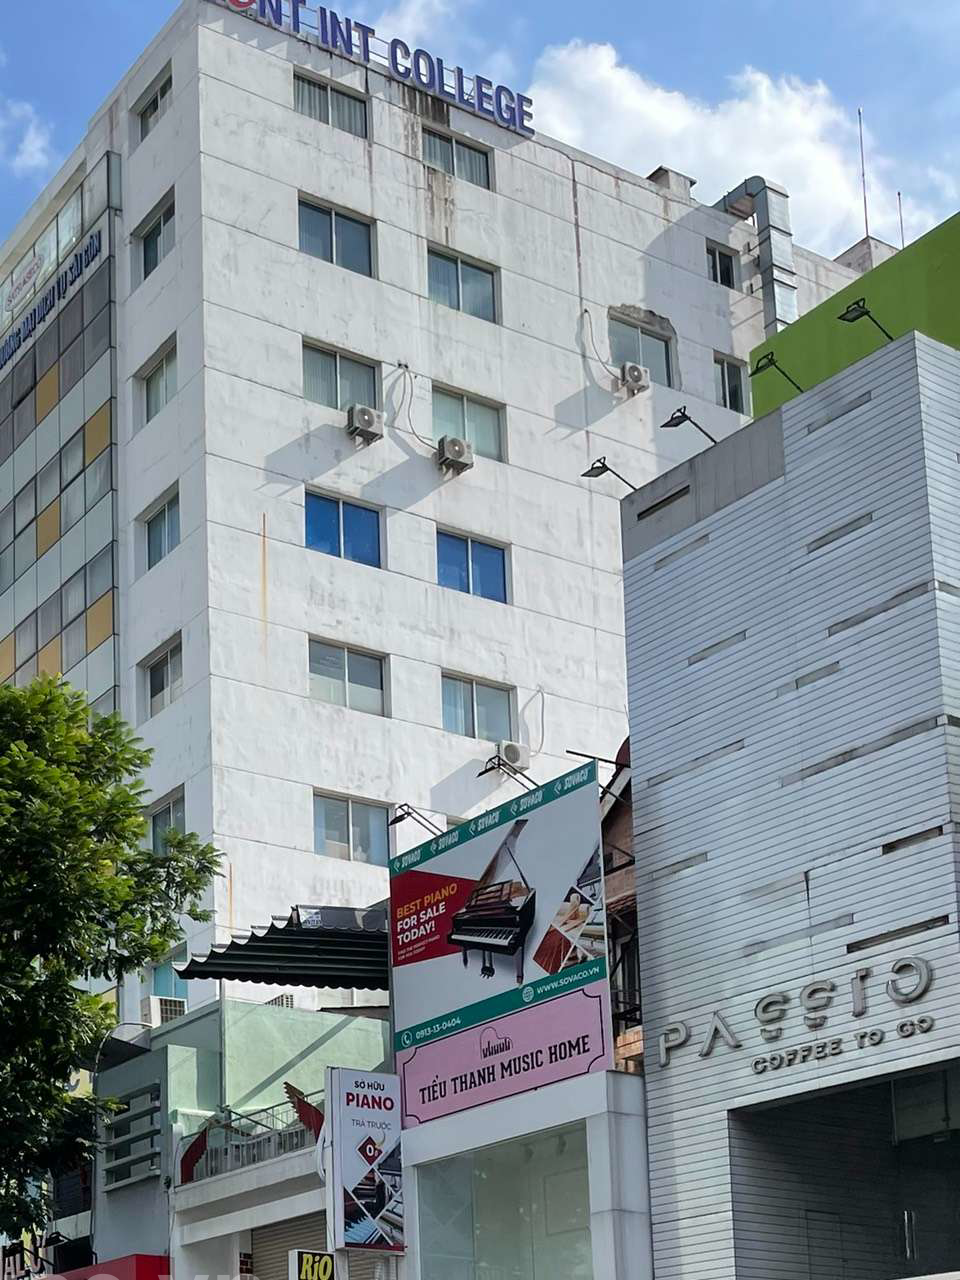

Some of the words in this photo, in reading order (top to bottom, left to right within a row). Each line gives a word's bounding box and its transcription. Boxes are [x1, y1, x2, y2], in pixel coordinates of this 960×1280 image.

[318, 6, 375, 63] INT
[389, 38, 536, 136] COLLEGE
[397, 899, 422, 919] BEST
[424, 883, 457, 907] PIANO
[397, 914, 417, 932] FOR
[420, 902, 446, 922] SALE
[397, 920, 435, 945] TODAY!
[536, 966, 600, 995] WWW.SOVACO.VN
[415, 1016, 461, 1040] 0913-13-0404
[658, 956, 934, 1069] PASSIO
[751, 1038, 844, 1075] COFFEE
[854, 1028, 885, 1050] TO
[896, 1015, 935, 1038] GO
[419, 1075, 447, 1105] TIỂU
[451, 1065, 495, 1095] THANH
[500, 1050, 544, 1080] MUSIC
[548, 1035, 591, 1063] HOME
[346, 1092, 394, 1112] PIANO
